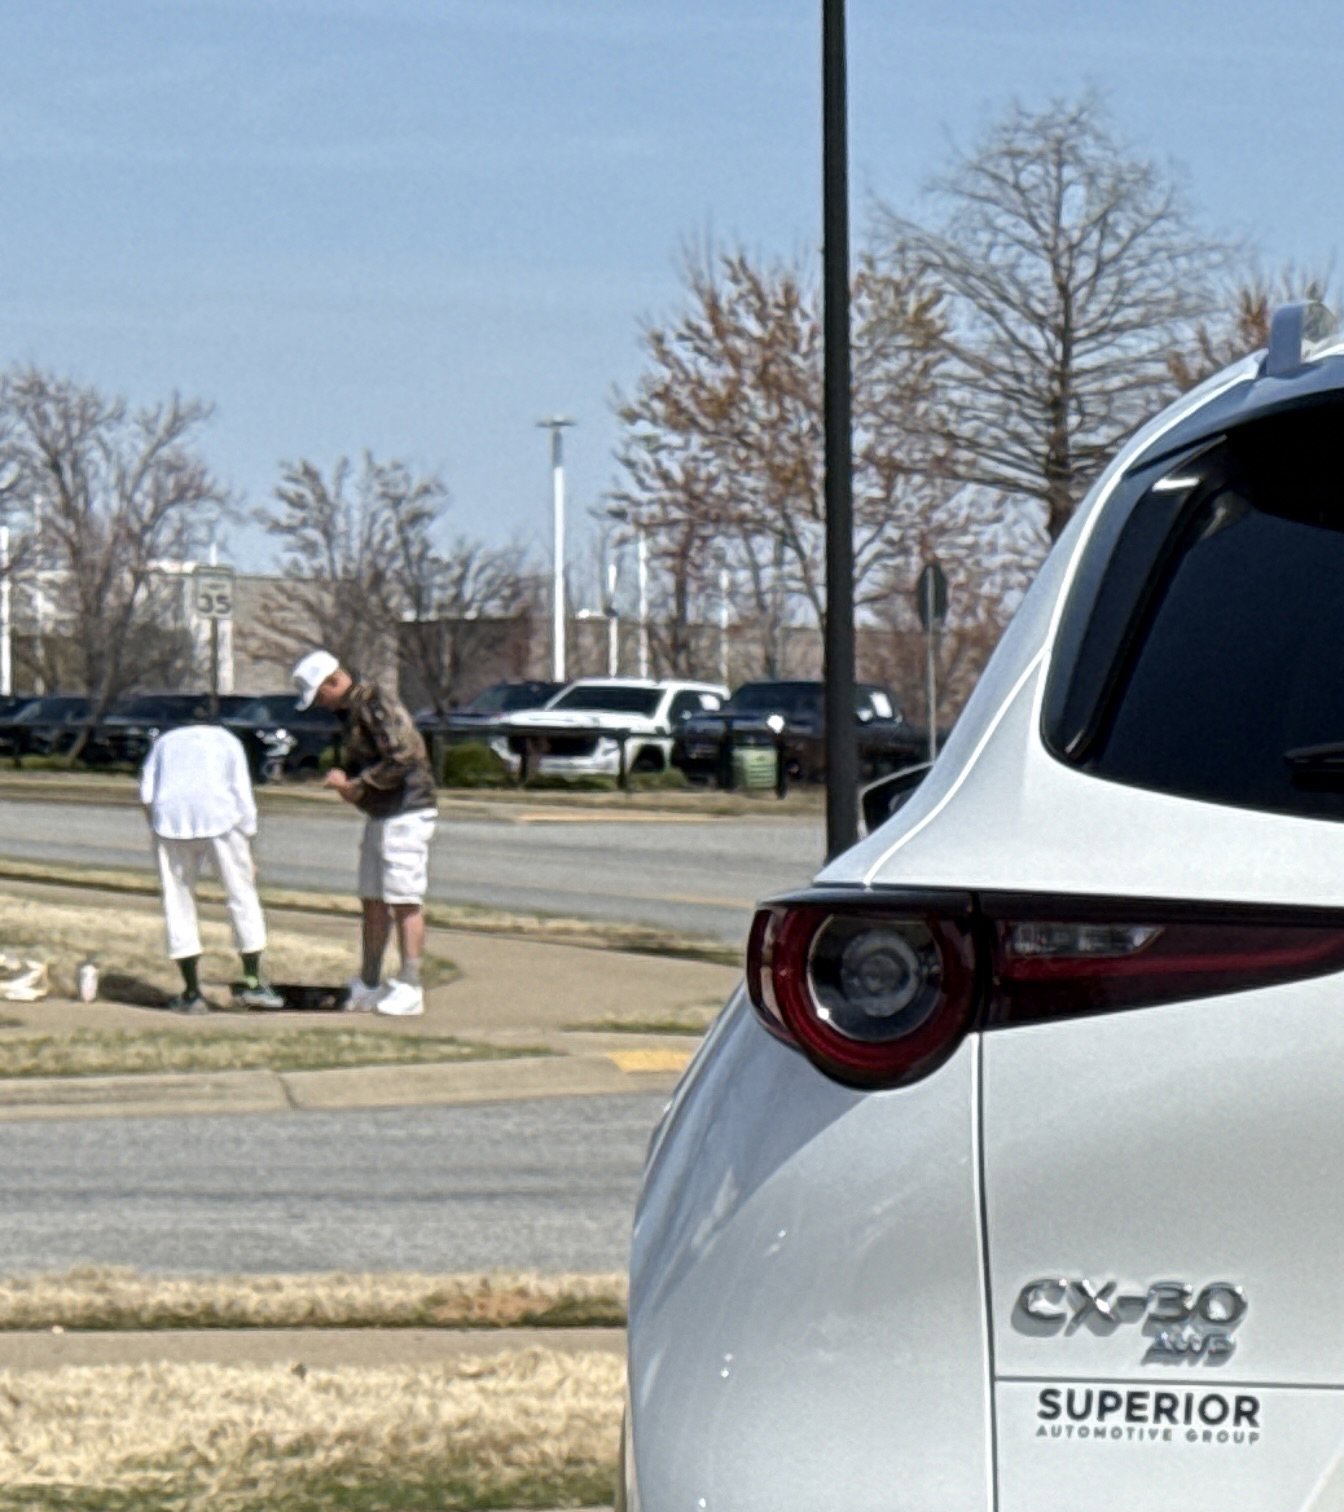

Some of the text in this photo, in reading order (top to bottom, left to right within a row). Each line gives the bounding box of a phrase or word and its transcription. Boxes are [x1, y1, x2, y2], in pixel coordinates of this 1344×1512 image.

[1014, 1278, 1248, 1328] CX-30
[1037, 1388, 1260, 1428] SUPERIOR
[1036, 1424, 1260, 1445] AUTOMOTIVE GROUP
